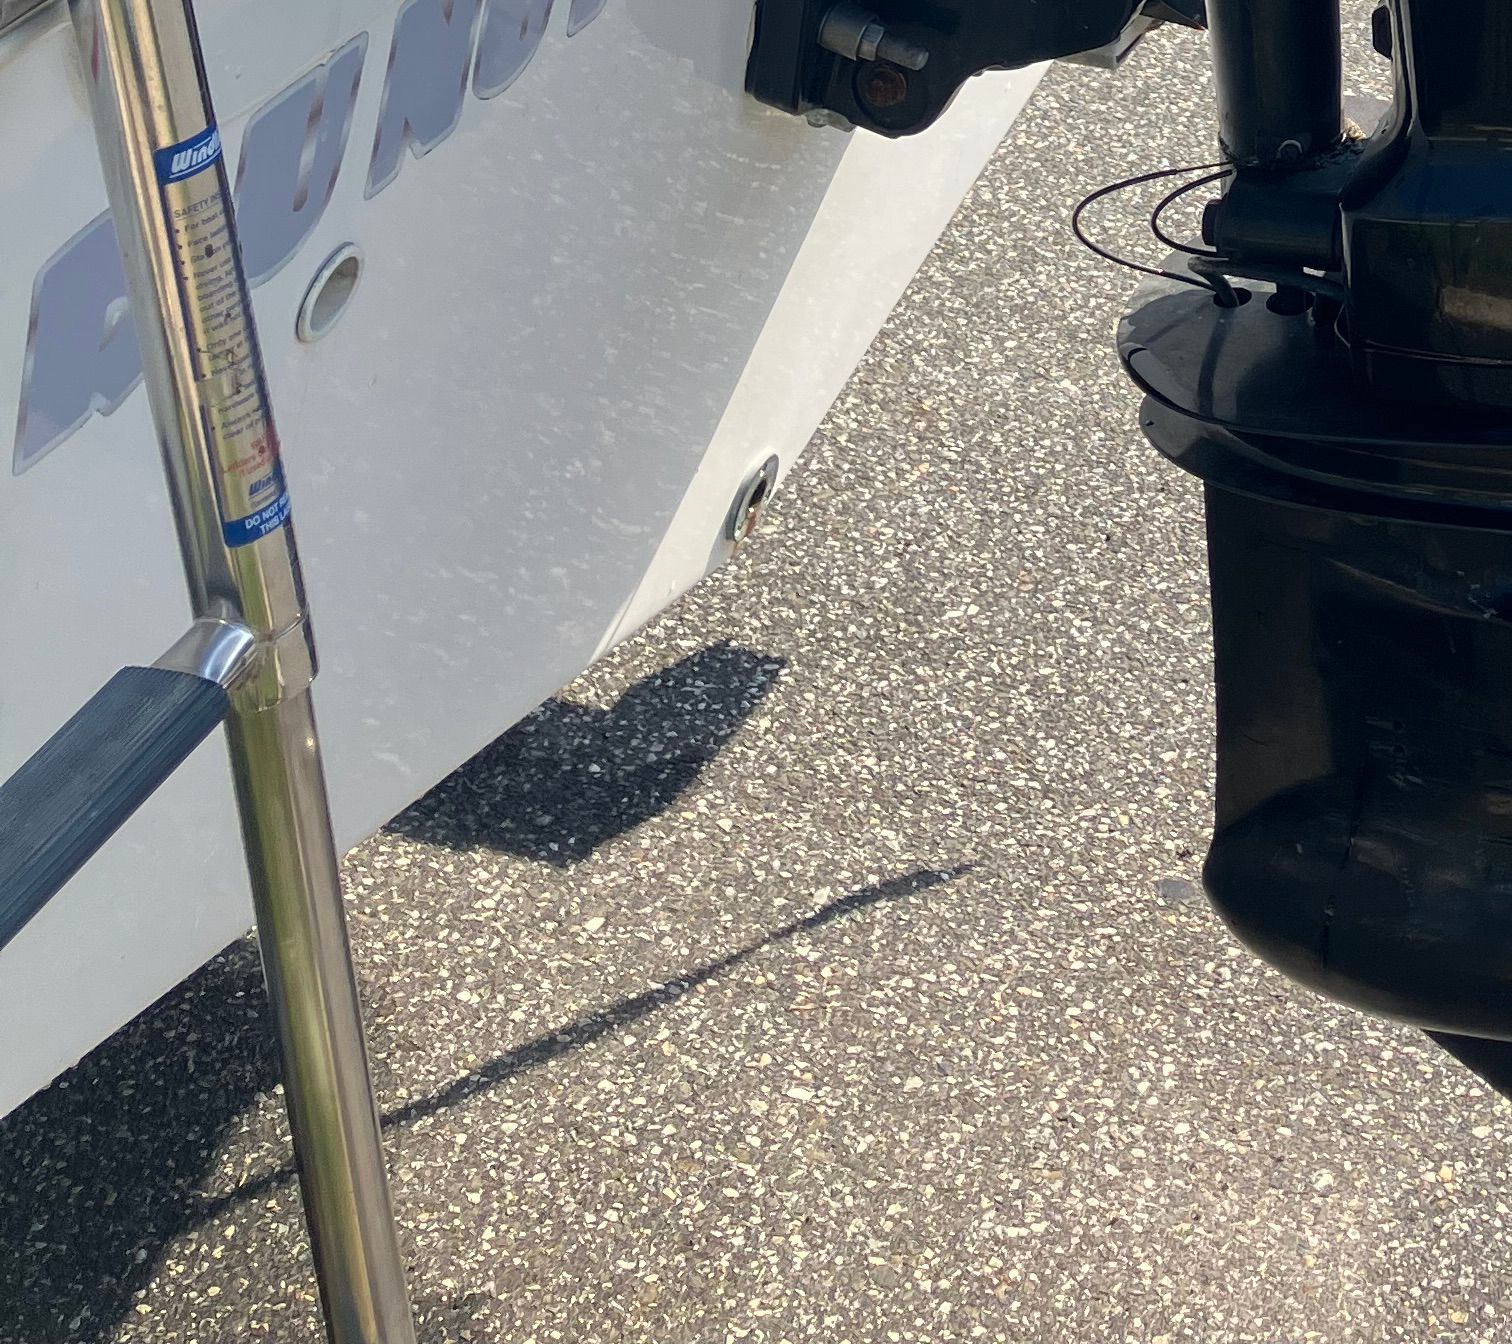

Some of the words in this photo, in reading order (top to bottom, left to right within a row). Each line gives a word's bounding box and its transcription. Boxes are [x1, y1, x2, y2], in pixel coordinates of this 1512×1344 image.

[234, 30, 369, 289] U
[174, 197, 210, 219] SAFETY
[244, 515, 260, 530] DO
[262, 502, 279, 520] NOT
[260, 516, 279, 535] THIS
